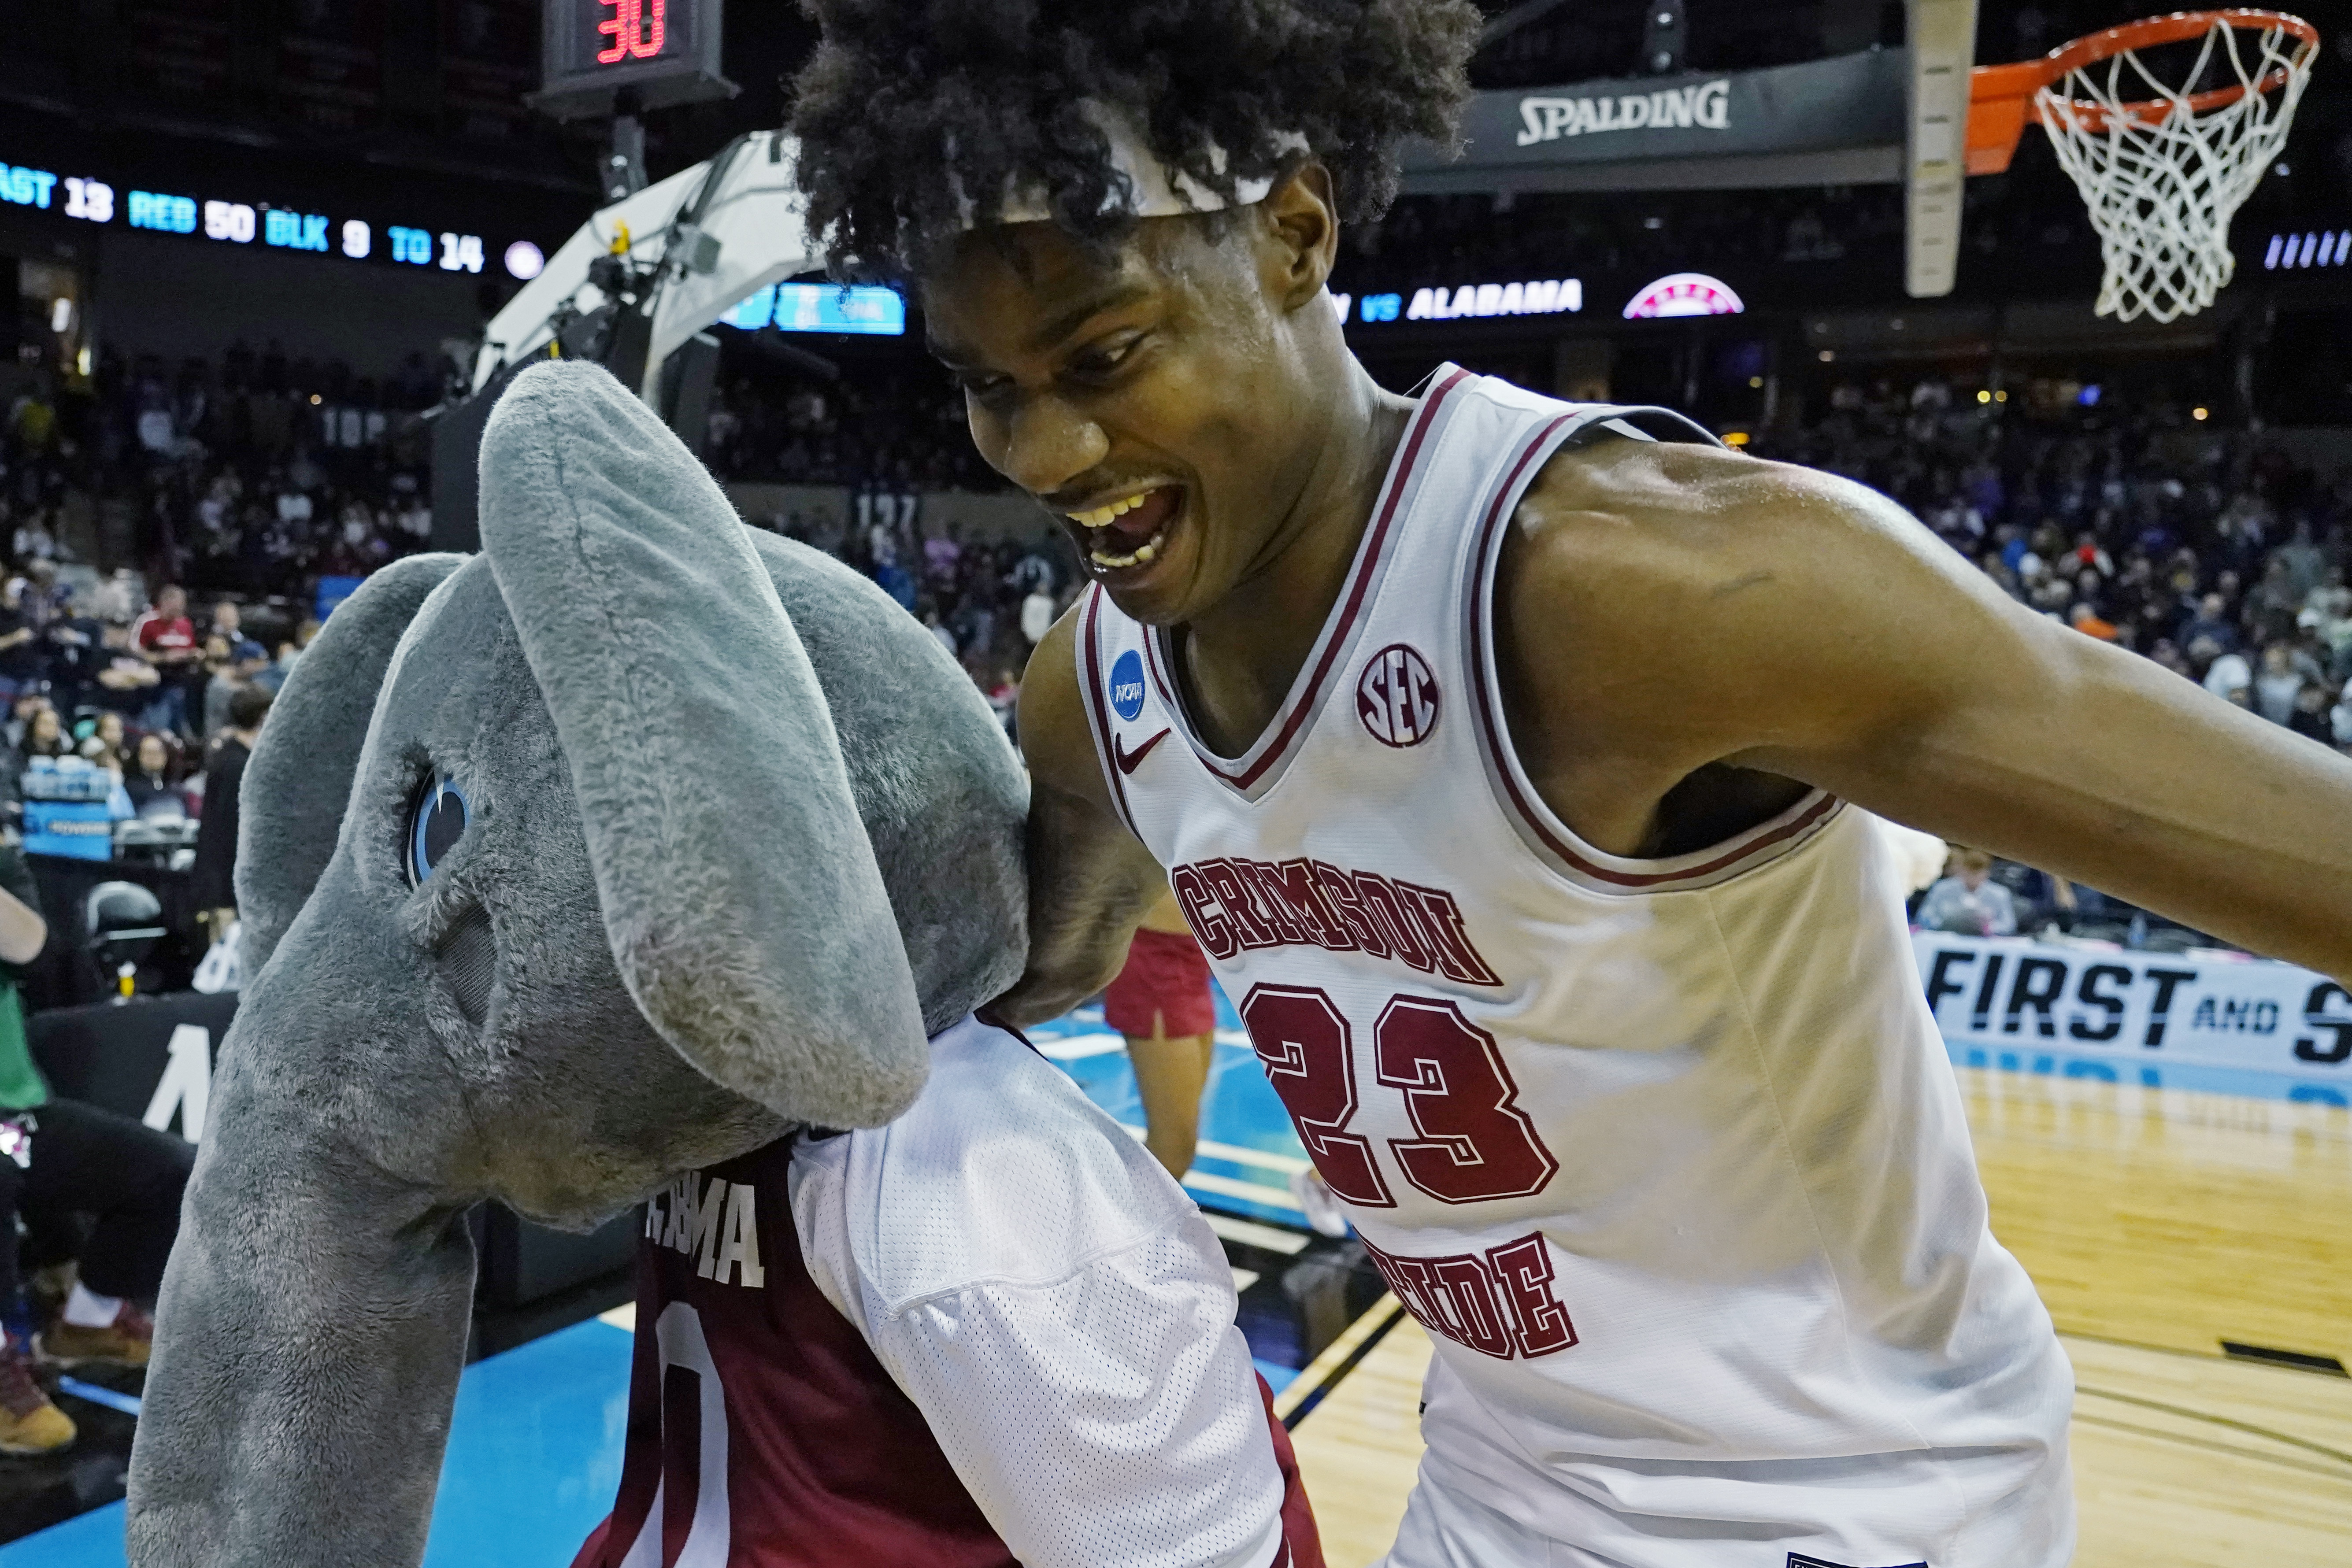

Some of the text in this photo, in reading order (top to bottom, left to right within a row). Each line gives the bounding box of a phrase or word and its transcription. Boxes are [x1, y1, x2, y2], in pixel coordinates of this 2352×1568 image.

[597, 0, 664, 63] 30
[1517, 79, 1731, 146] SPALDING
[64, 177, 114, 223] 13
[128, 190, 197, 234] REB
[204, 200, 256, 243] 50
[265, 209, 330, 252] BLK
[342, 219, 370, 258] 9
[388, 226, 432, 264] TO
[440, 232, 485, 274] 14
[1407, 278, 1583, 320] ALABAMA
[1115, 682, 1142, 703] NCAA
[1361, 649, 1434, 743] SEC
[1171, 857, 1504, 986] CRIMSON
[1925, 951, 2197, 1047] FIRST
[2190, 995, 2278, 1035] AND
[1239, 982, 1559, 1207] 23
